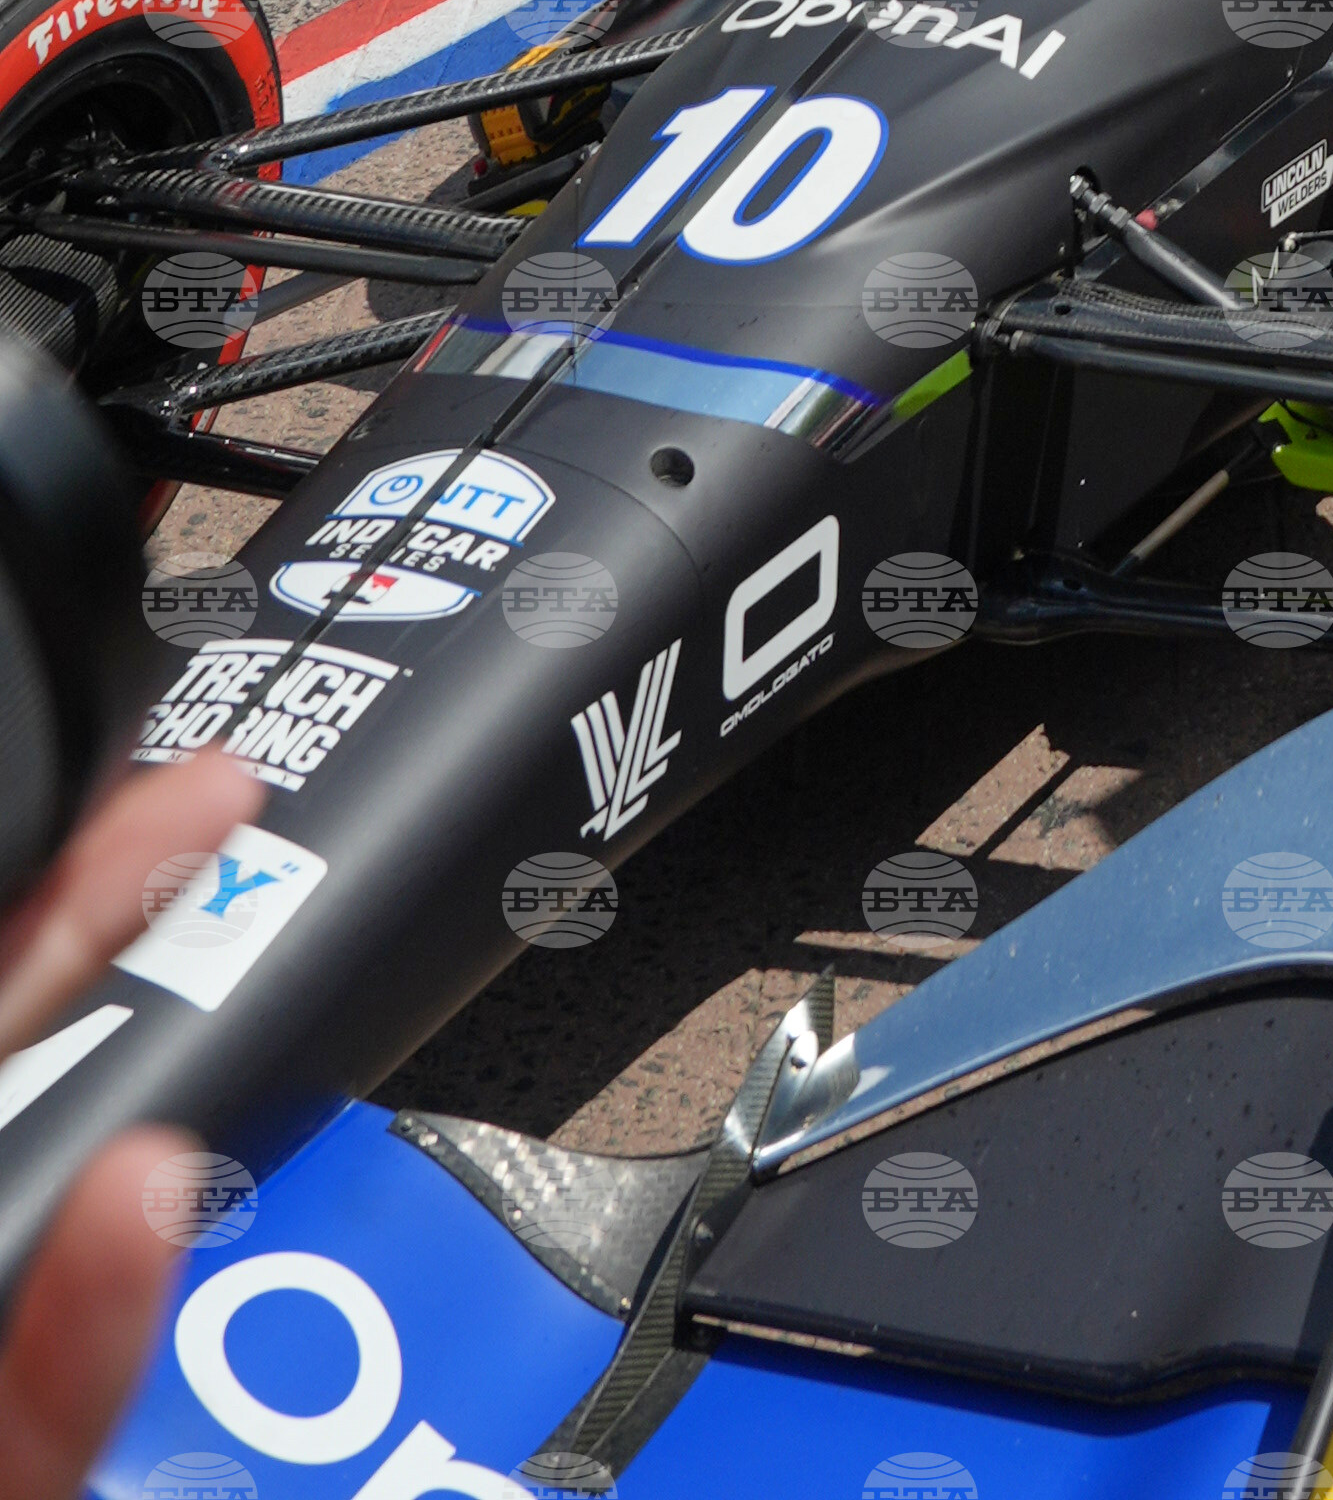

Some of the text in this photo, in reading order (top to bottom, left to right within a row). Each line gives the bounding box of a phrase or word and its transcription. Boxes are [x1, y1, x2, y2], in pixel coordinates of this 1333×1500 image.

[575, 85, 890, 266] 10
[1264, 145, 1326, 207] LINCOLN
[1277, 170, 1328, 218] WELDERS
[304, 517, 512, 572] INDCAR
[330, 541, 447, 573] SEIES
[160, 652, 386, 731] TRENCH
[720, 631, 836, 738] OMOLOGATO
